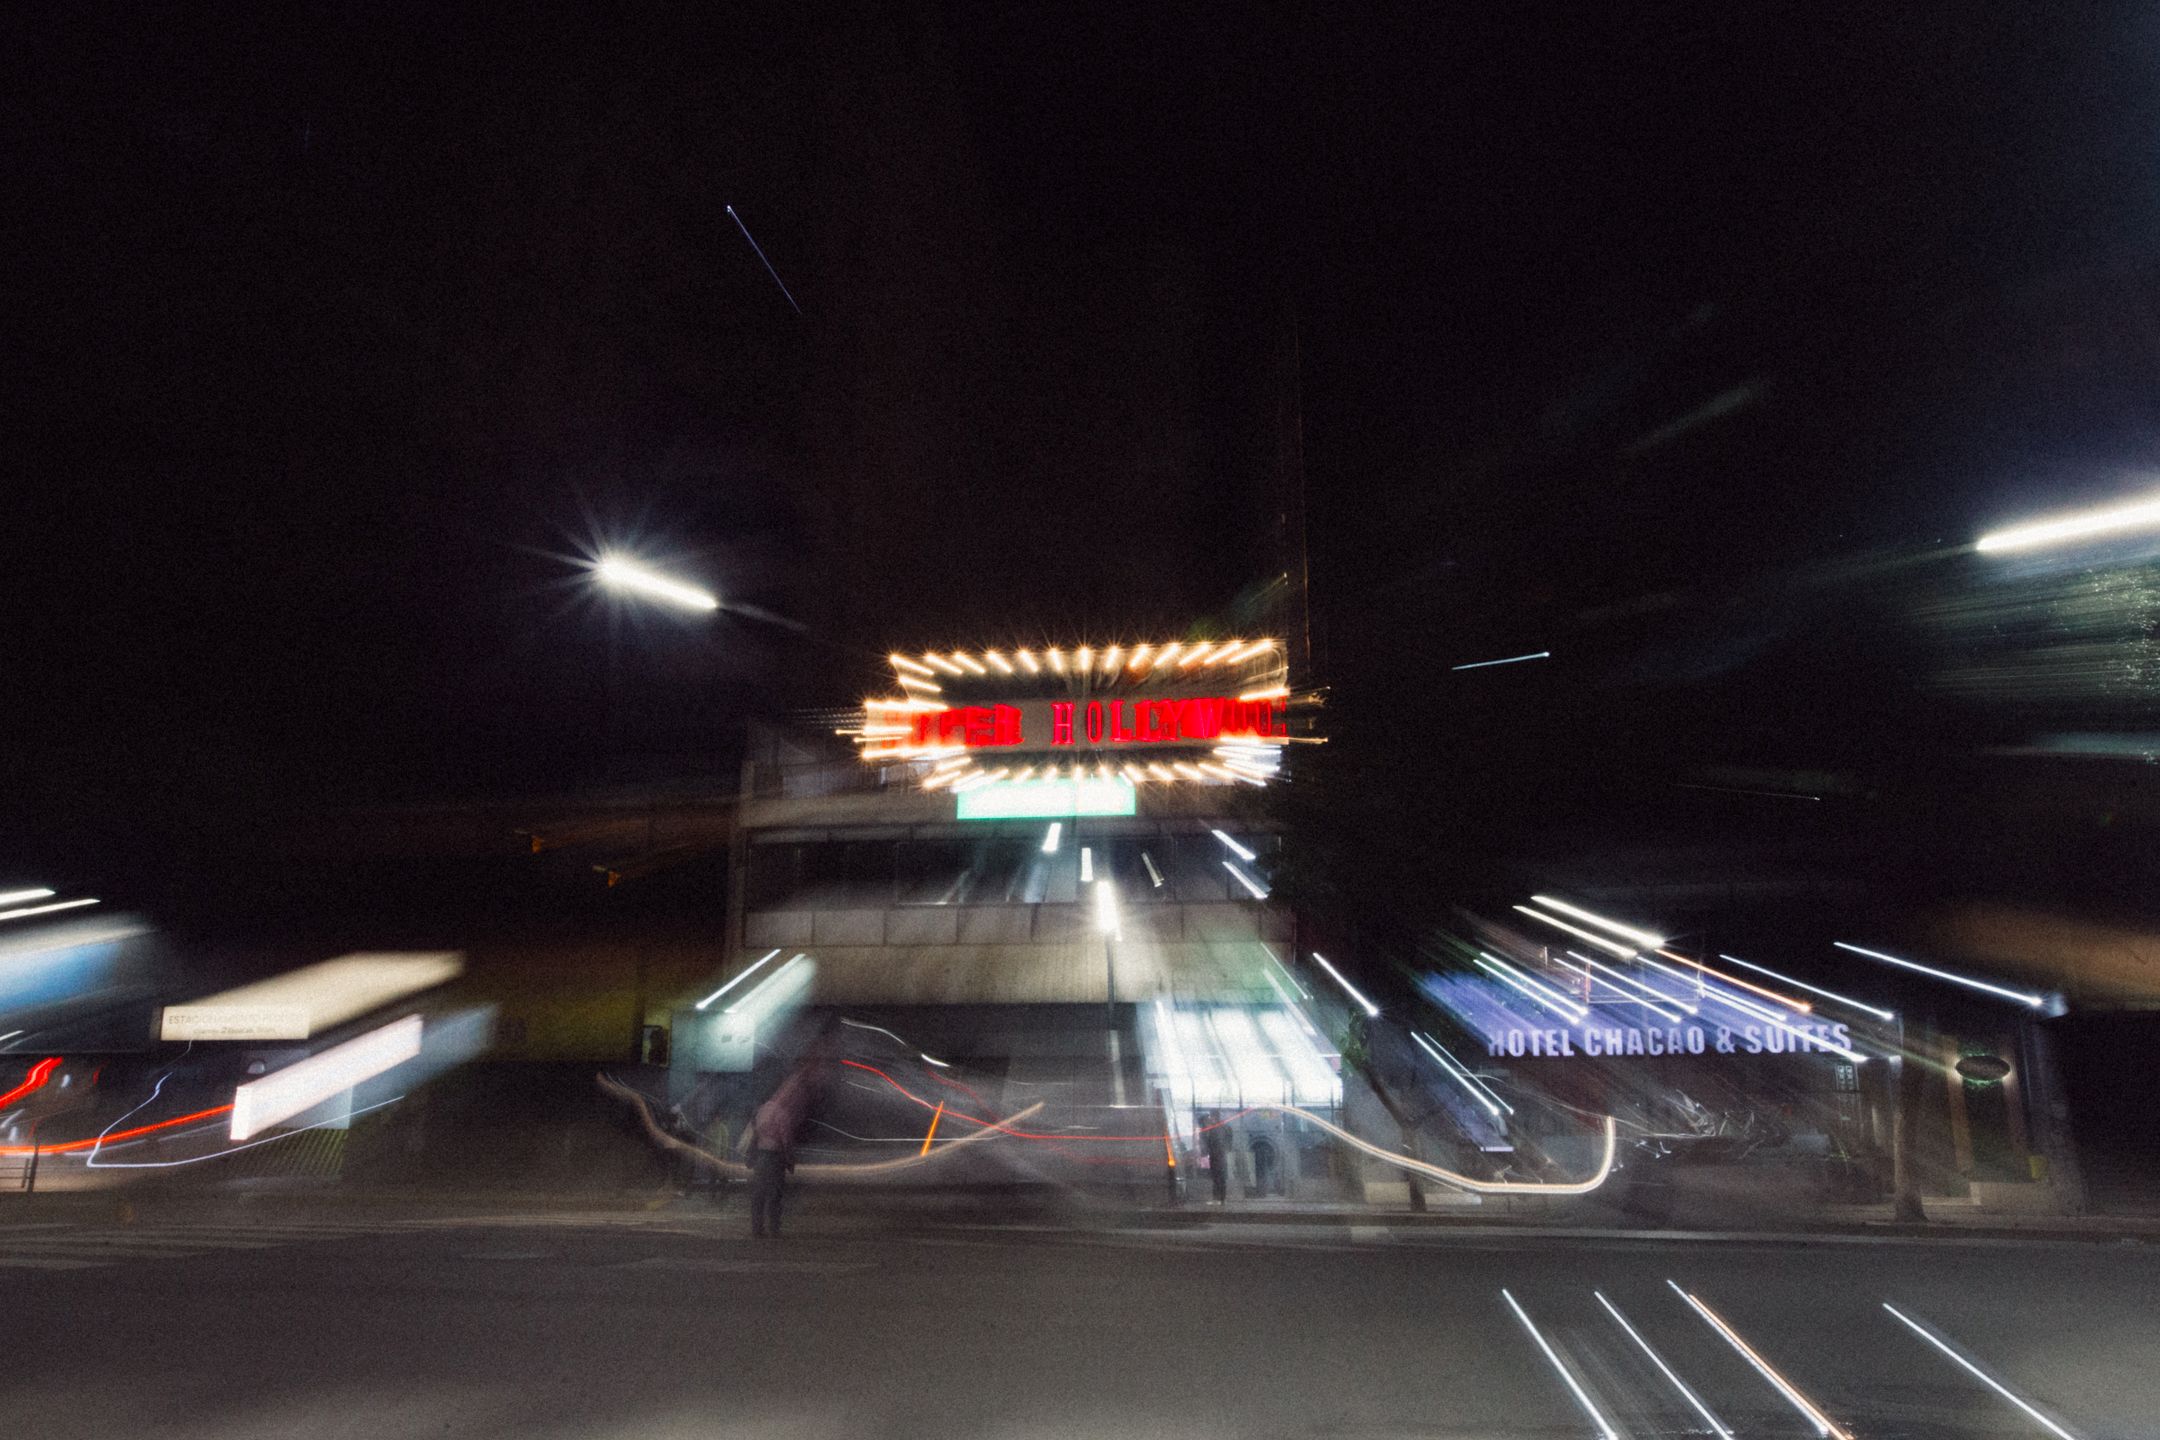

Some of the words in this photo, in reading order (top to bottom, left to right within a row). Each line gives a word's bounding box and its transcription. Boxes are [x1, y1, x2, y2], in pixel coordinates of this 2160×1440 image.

[1051, 697, 1286, 745] HOLLYWOO
[1488, 1029, 1575, 1057] HOTEL
[1584, 1026, 1705, 1057] CHACAO
[1716, 1026, 1735, 1053] &
[1744, 1023, 1852, 1054] SUITES
